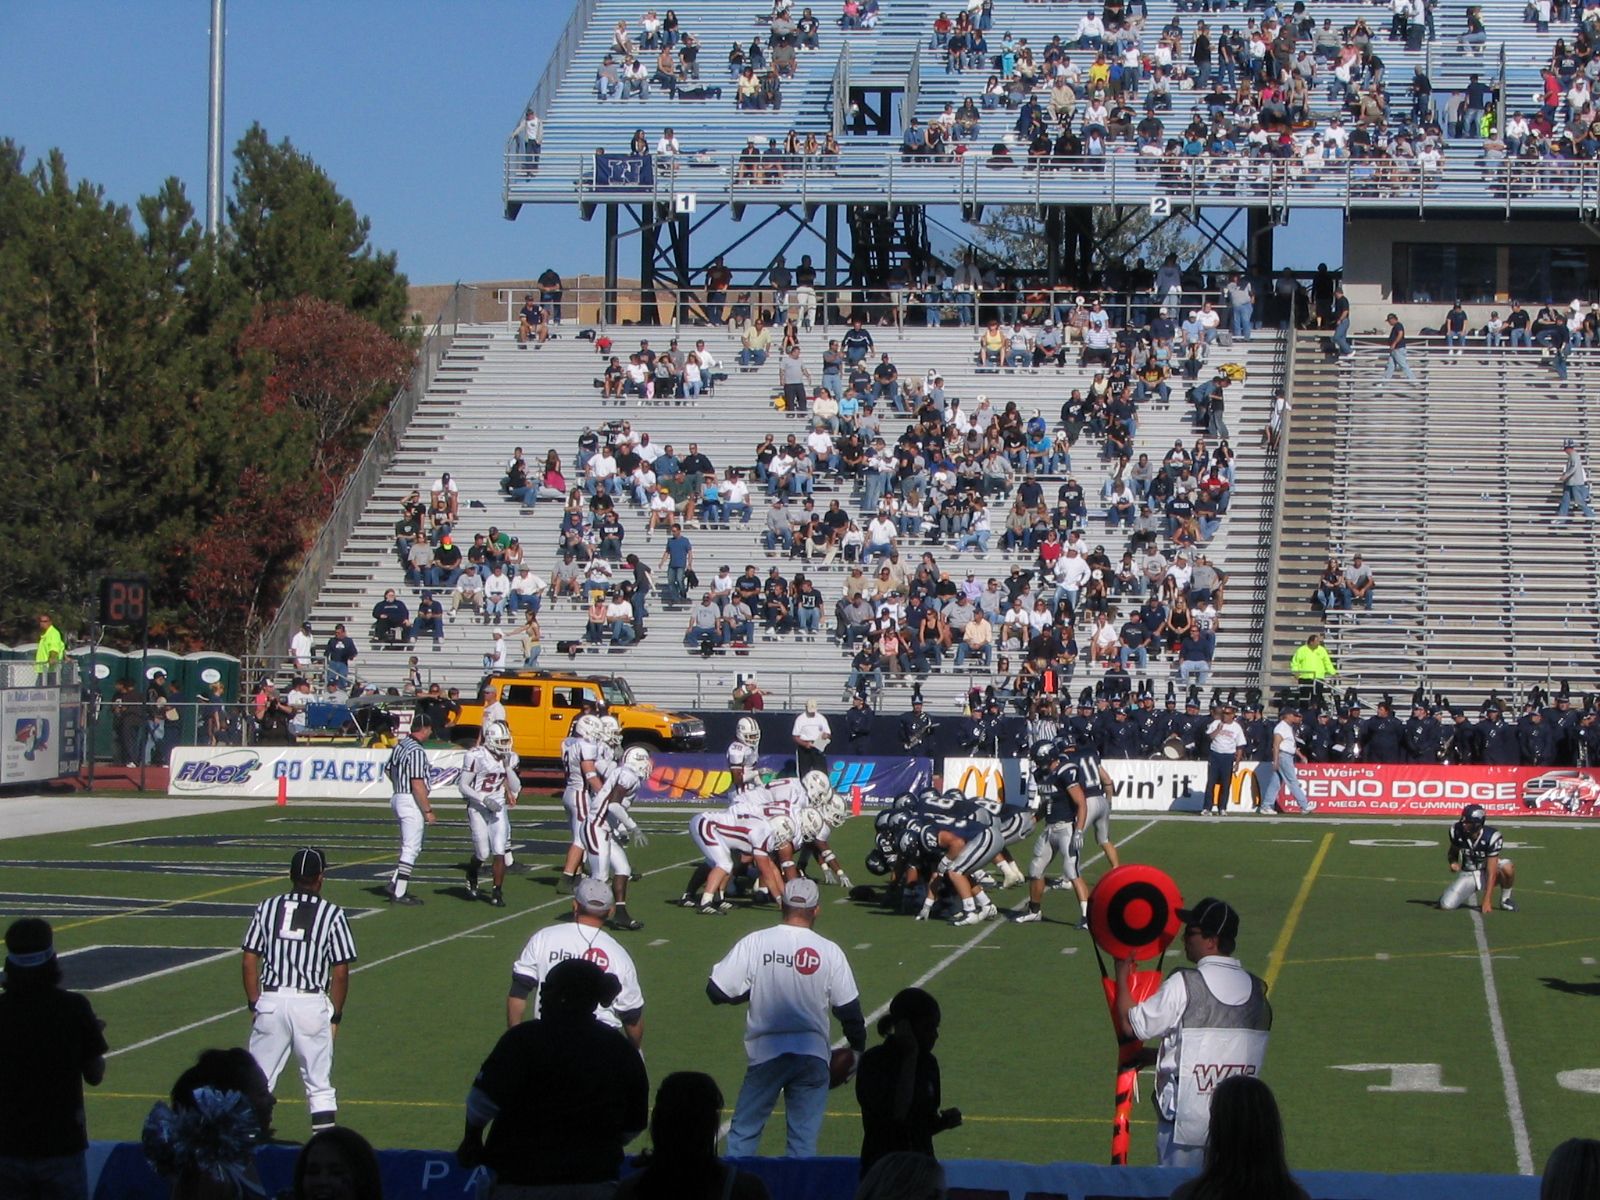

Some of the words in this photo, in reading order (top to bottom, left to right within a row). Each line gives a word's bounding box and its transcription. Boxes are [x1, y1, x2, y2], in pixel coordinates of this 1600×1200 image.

[681, 196, 690, 210] 1
[1154, 198, 1167, 213] 2
[174, 759, 262, 784] Fleet
[274, 760, 302, 781] GO
[310, 760, 384, 782] PACK!
[1069, 769, 1077, 782] 7
[1080, 756, 1101, 787] 11
[1322, 768, 1375, 777] Weir's
[1392, 781, 1517, 800] DODGE
[1328, 800, 1365, 808] MEGA
[1370, 801, 1398, 809] CAB
[280, 900, 305, 940] L
